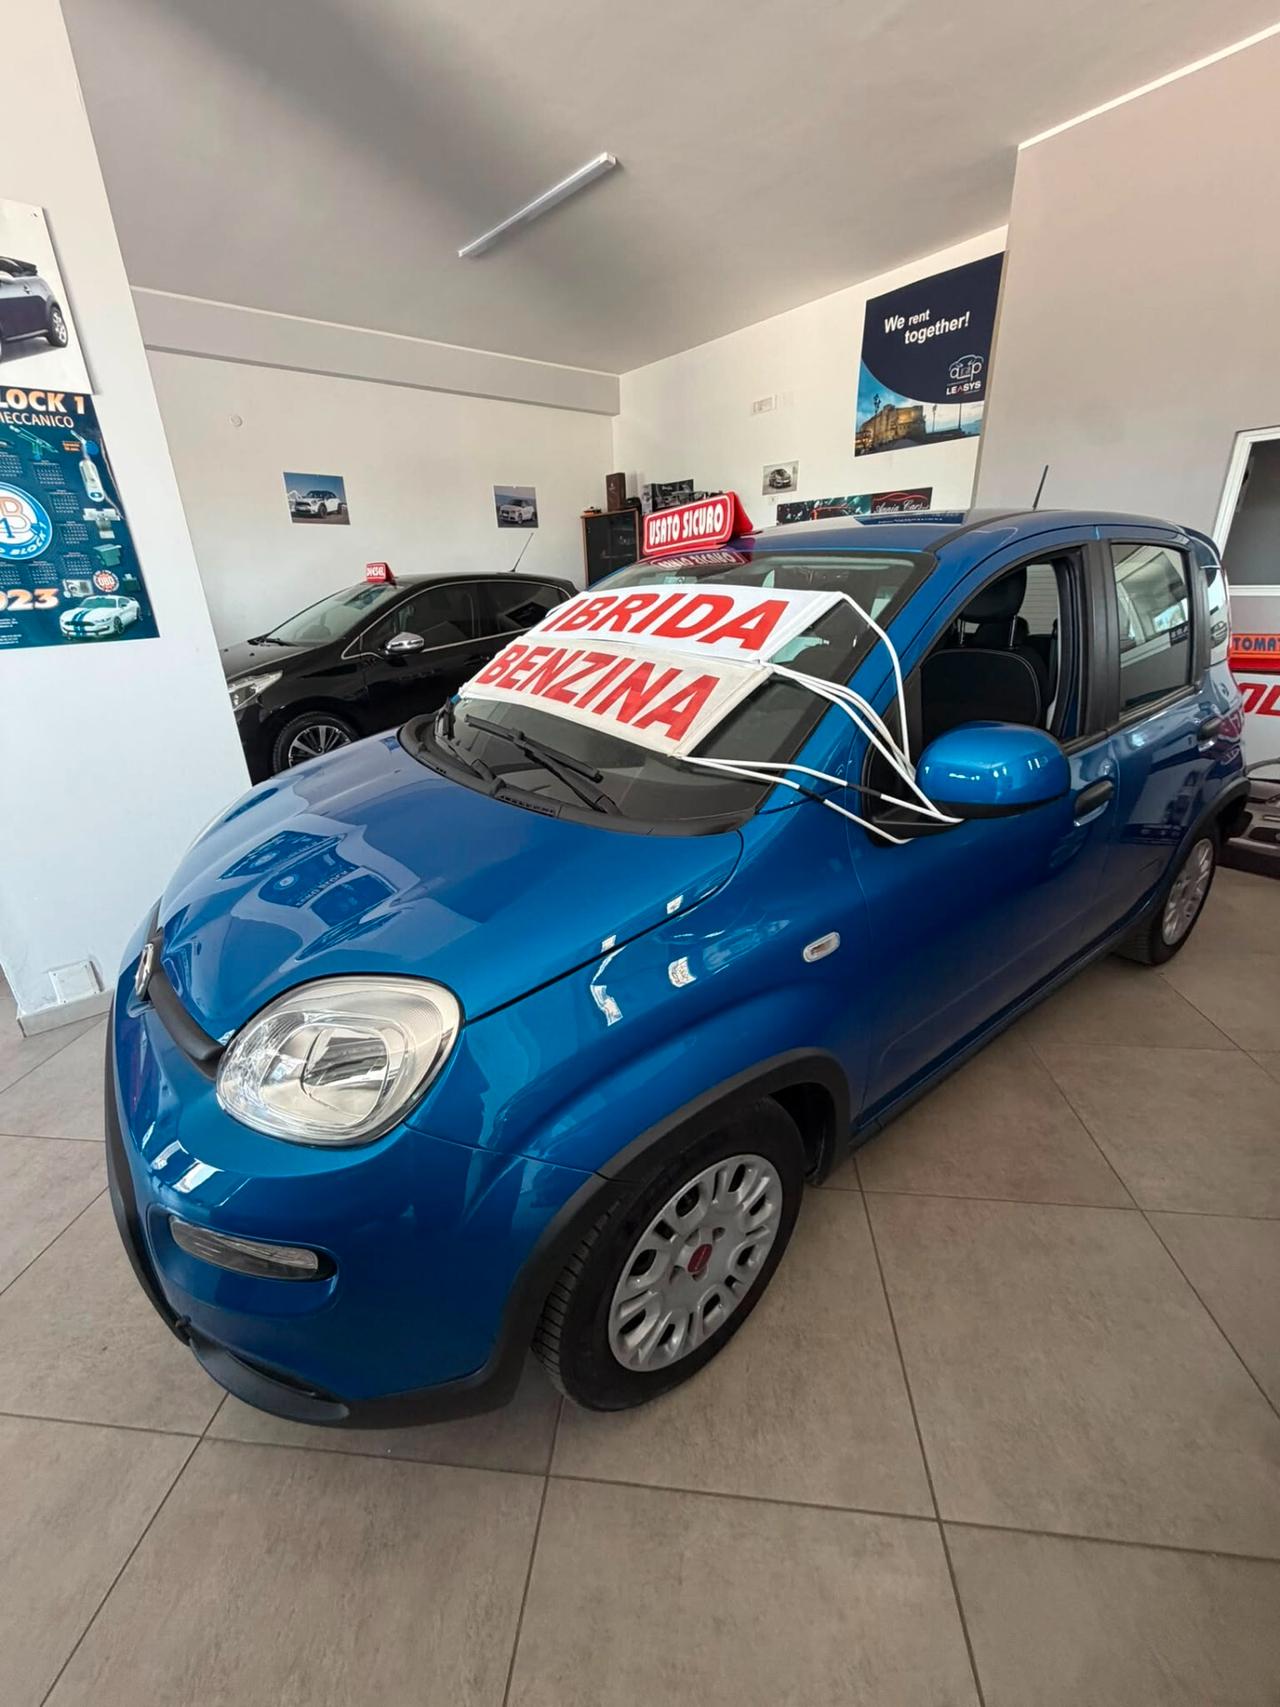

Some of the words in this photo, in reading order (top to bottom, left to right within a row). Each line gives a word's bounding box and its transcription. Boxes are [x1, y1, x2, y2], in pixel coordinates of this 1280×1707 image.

[884, 314, 905, 334] We
[908, 308, 930, 326] rent
[904, 311, 970, 345] together!
[946, 380, 982, 396] LEASYS
[74, 395, 85, 415] 1
[649, 514, 680, 547] USATO
[682, 503, 724, 539] SICURO
[541, 593, 790, 651] IBRIDA
[1233, 636, 1280, 652] TOMA
[476, 644, 720, 742] BENZINA
